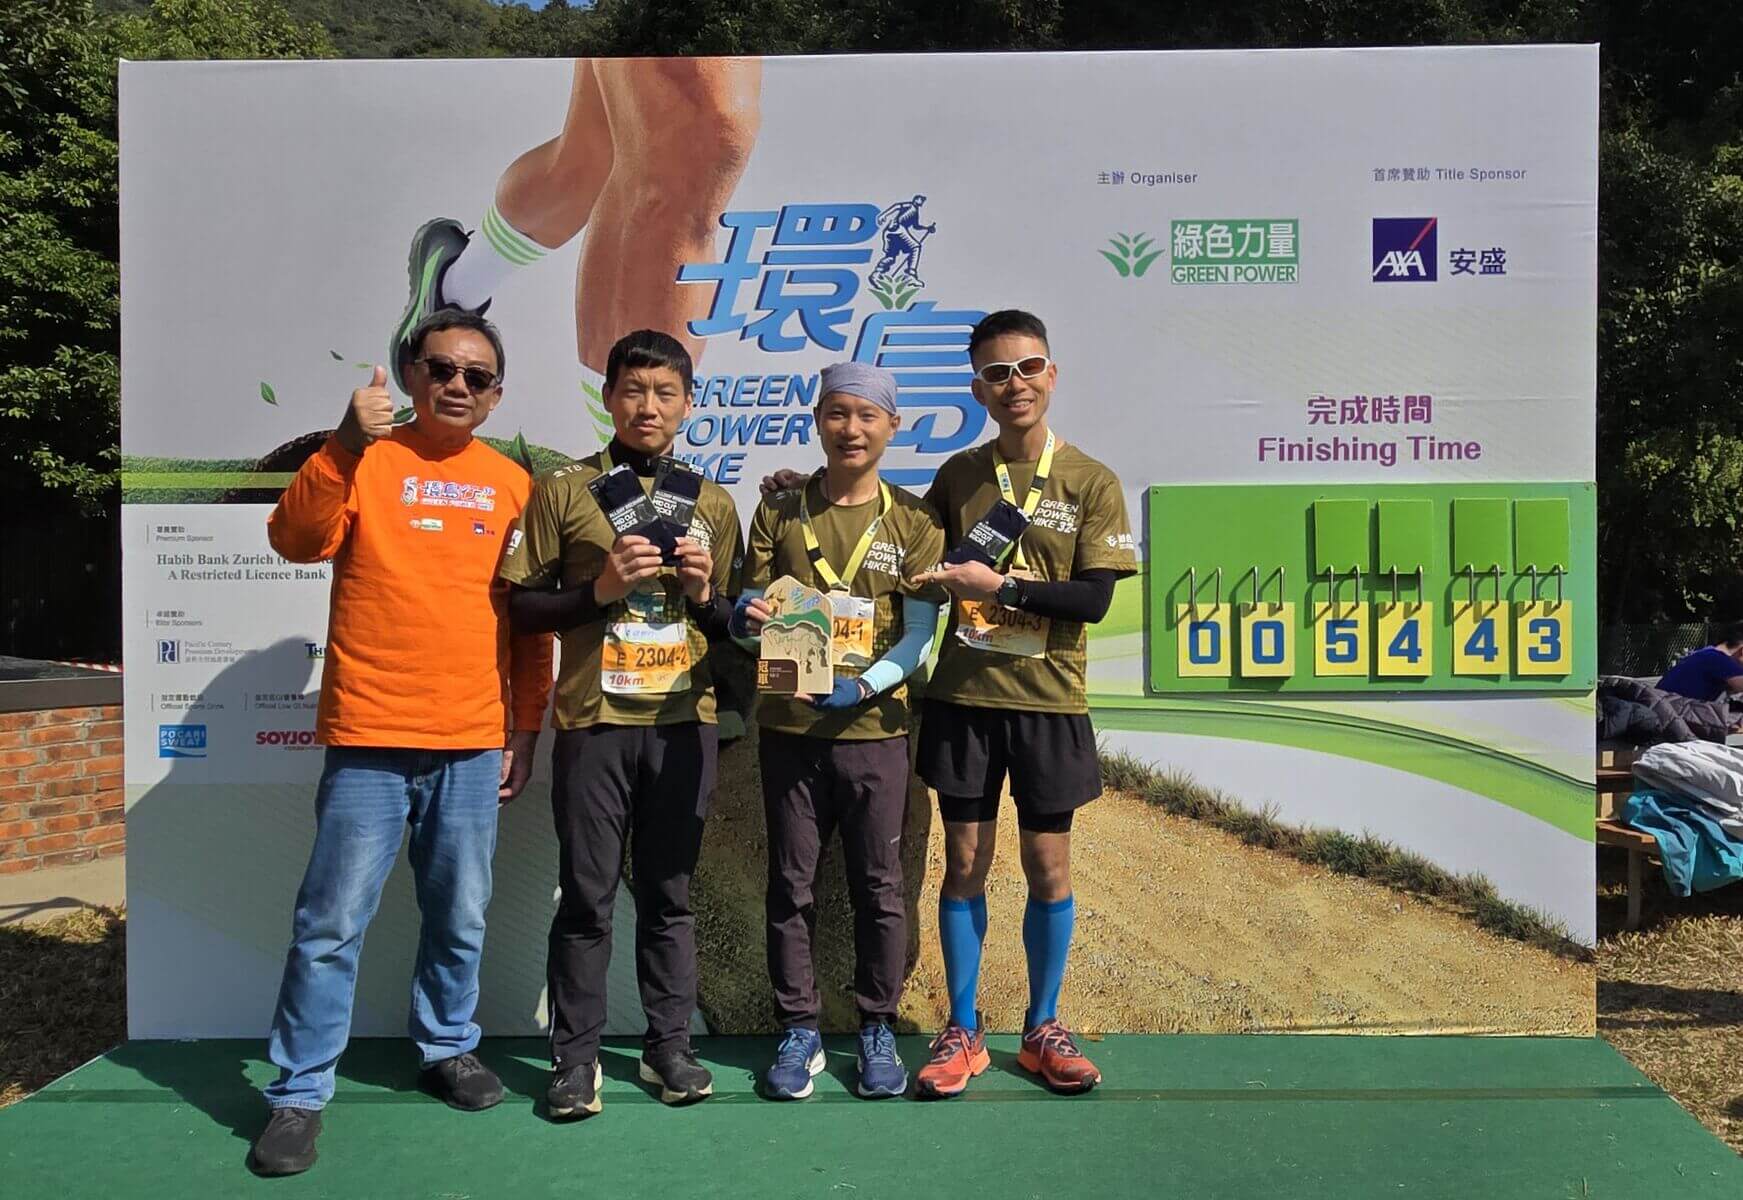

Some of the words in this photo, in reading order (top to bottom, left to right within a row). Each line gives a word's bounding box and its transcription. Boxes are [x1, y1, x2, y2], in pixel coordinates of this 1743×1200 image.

[1130, 172, 1198, 186] Organiser
[1436, 168, 1465, 180] Title
[1469, 168, 1527, 182] Sponsor
[1373, 251, 1427, 276] AXA
[1450, 248, 1507, 275] 安盛
[1173, 266, 1230, 282] GREEN
[1234, 265, 1296, 282] POWER
[1307, 395, 1433, 425] 完成時間
[1258, 436, 1397, 467] Finishing
[1406, 435, 1481, 461] Time
[673, 452, 748, 485] KE
[1041, 499, 1080, 514] GREEN
[1035, 508, 1077, 524] POWER
[157, 554, 194, 565] Habib
[198, 554, 229, 565] Bank
[232, 553, 273, 565] Zurich
[862, 560, 889, 573] HIKE
[168, 570, 178, 580] A
[181, 569, 242, 580] Restricted
[245, 569, 291, 580] Licence
[295, 569, 327, 580] Bank
[969, 606, 980, 621] E
[617, 651, 626, 666] E
[635, 646, 688, 668] 2304-2
[608, 674, 644, 685] 10km
[160, 730, 205, 738] POCARI
[160, 739, 200, 747] SWEAT
